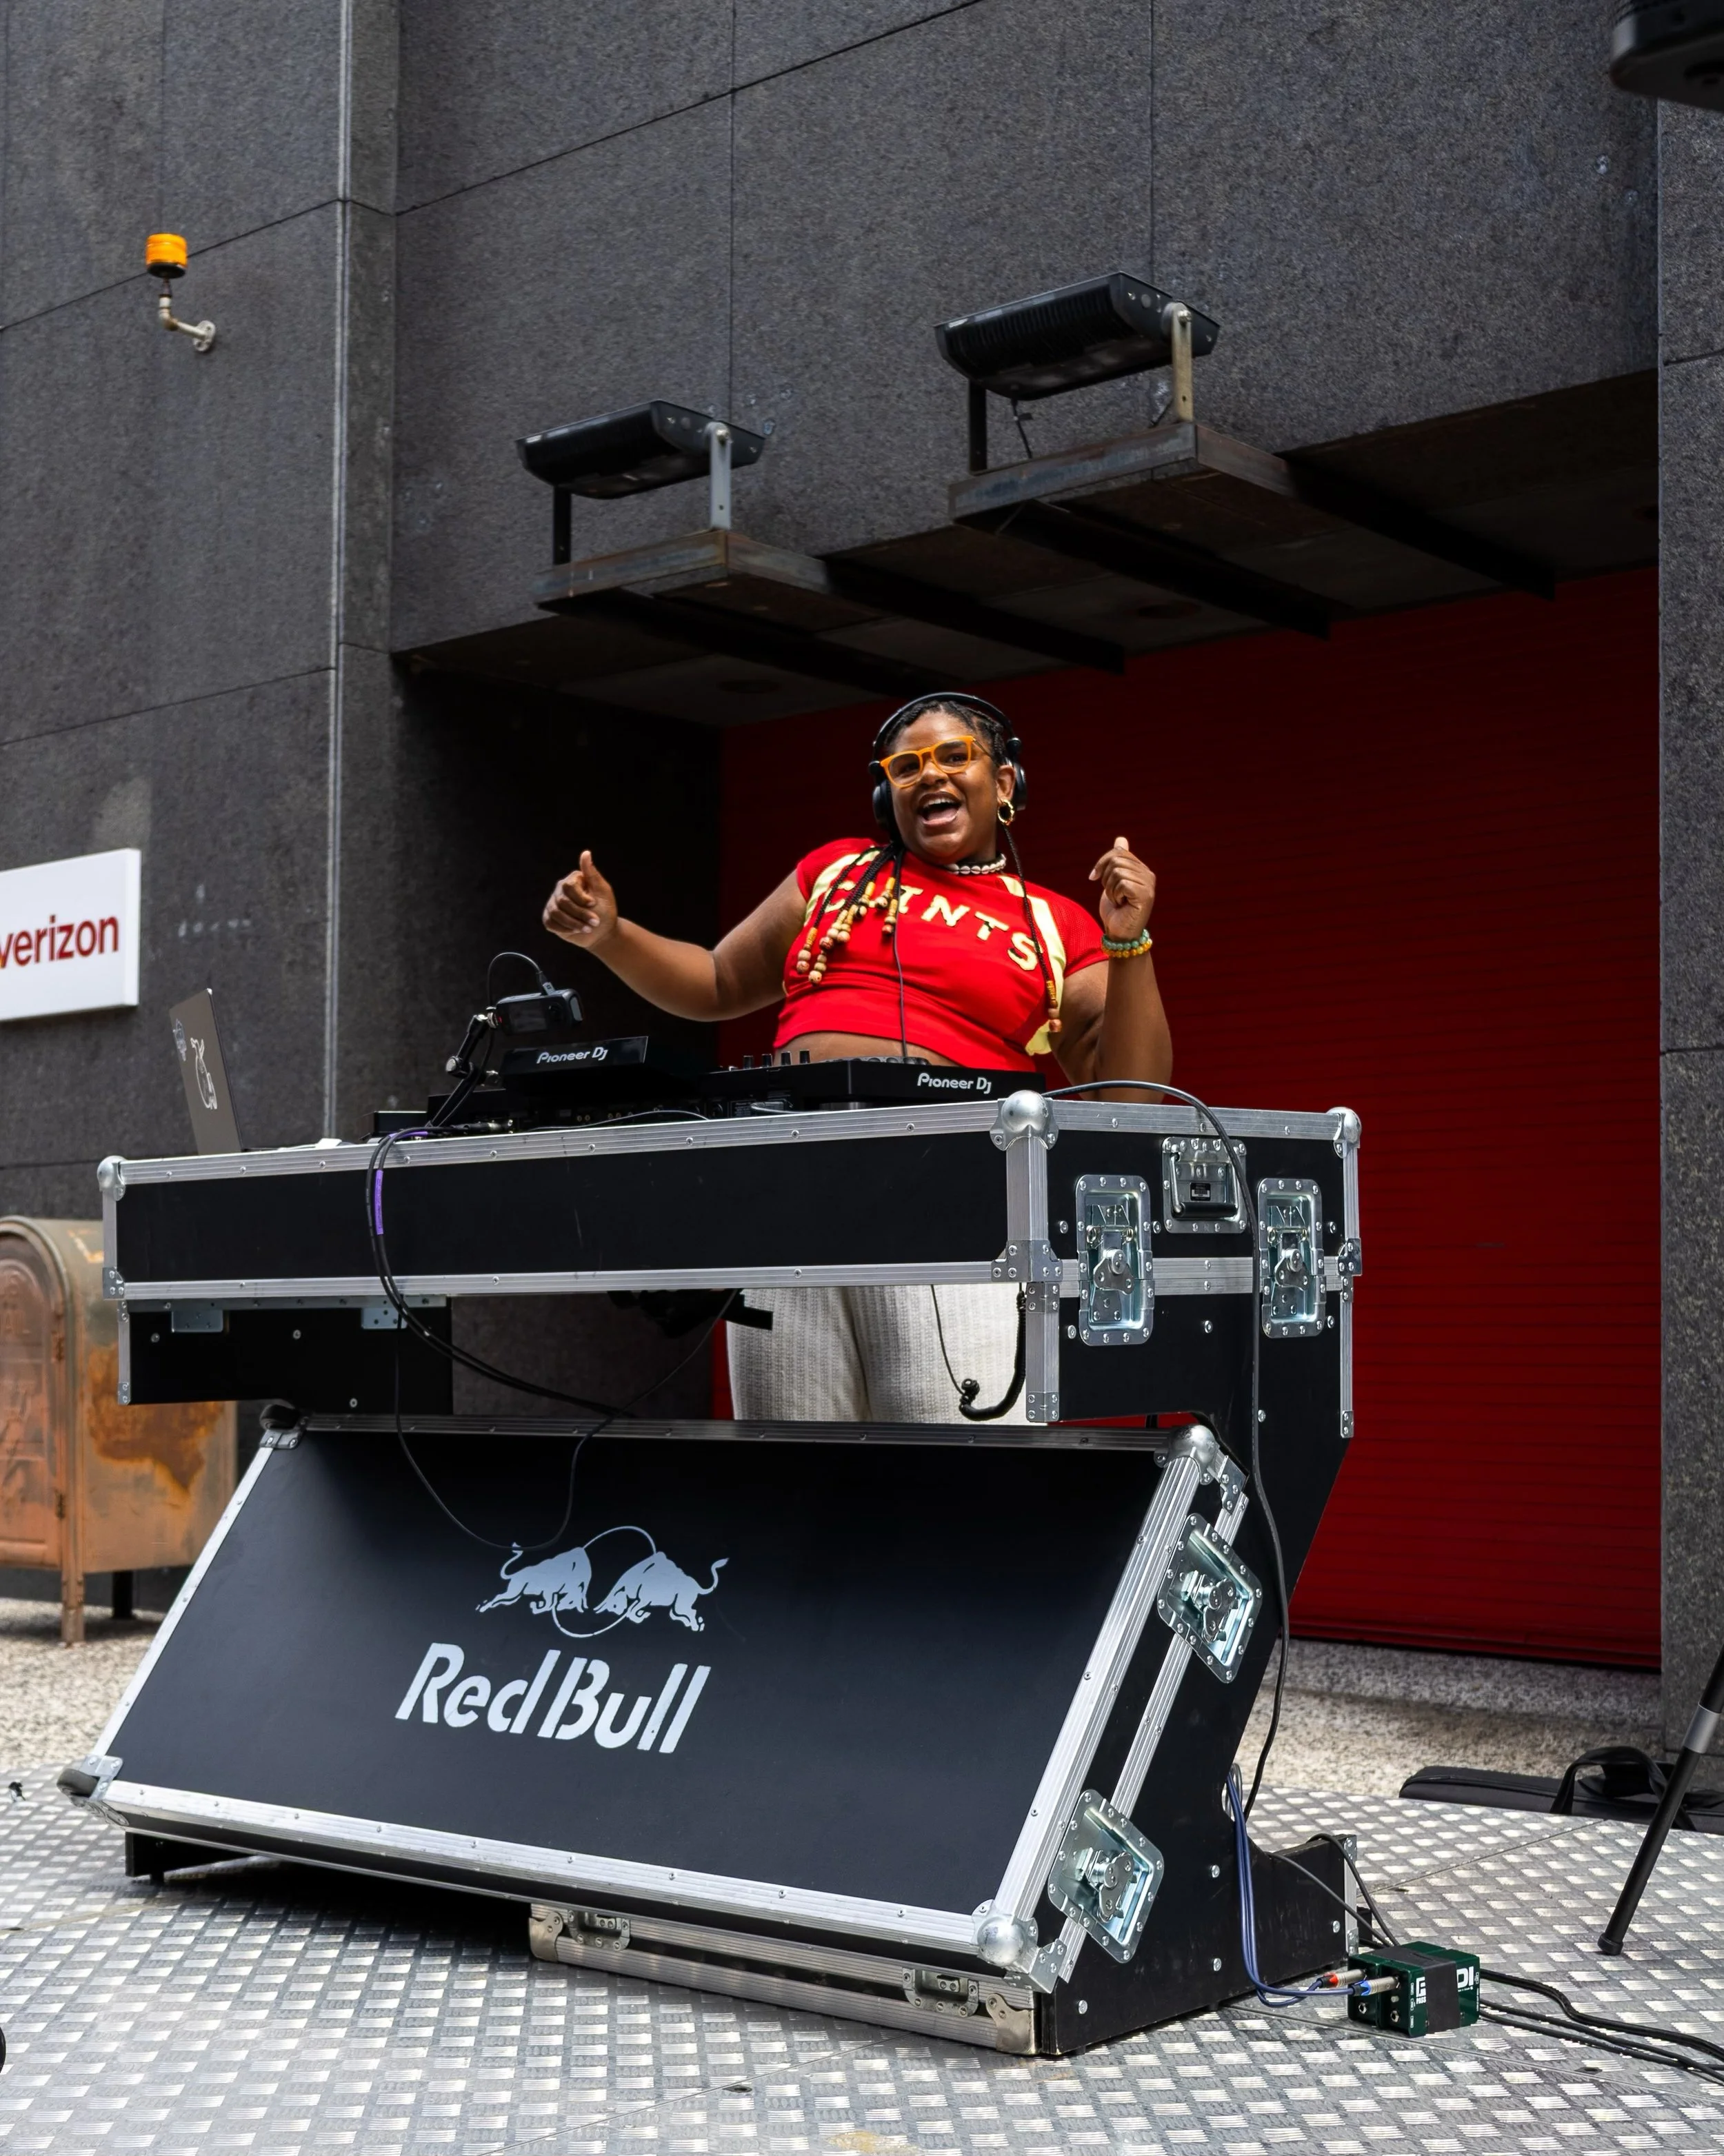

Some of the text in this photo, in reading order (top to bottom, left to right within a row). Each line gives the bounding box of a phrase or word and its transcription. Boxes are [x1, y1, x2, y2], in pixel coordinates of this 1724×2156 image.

[0, 914, 119, 969] verizon
[536, 1051, 590, 1064] Pioneer
[917, 1072, 974, 1089] Pioneer
[394, 1642, 712, 1753] Red Bull
